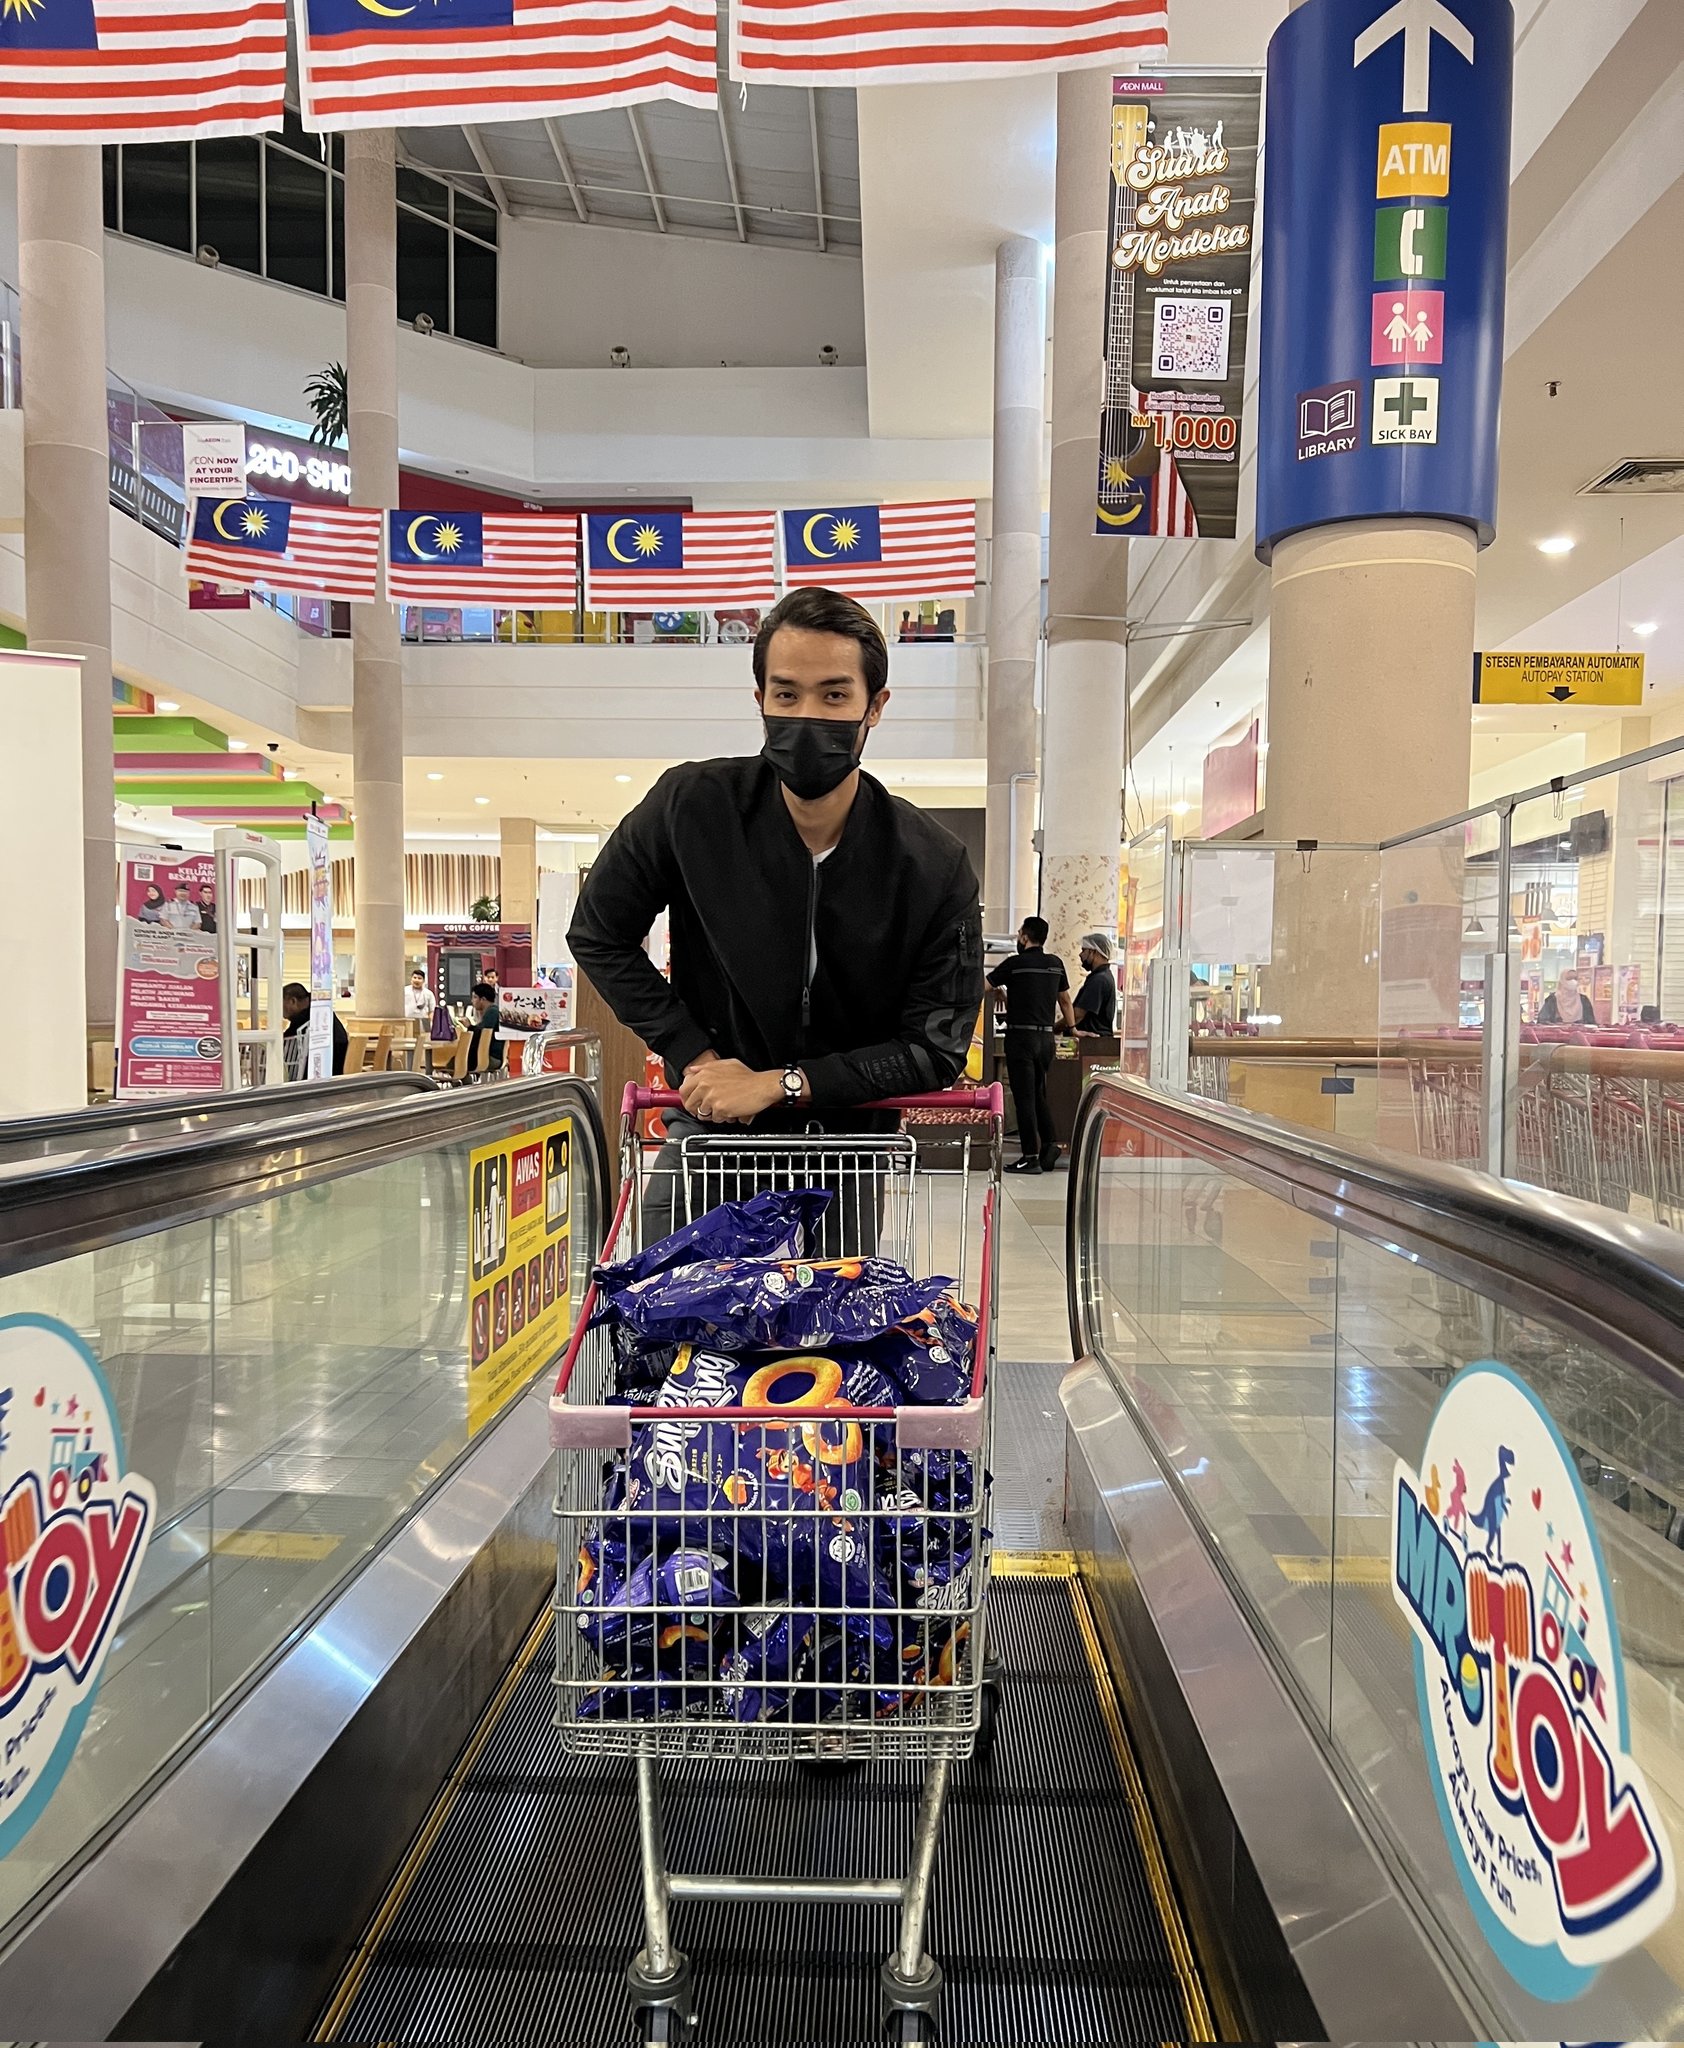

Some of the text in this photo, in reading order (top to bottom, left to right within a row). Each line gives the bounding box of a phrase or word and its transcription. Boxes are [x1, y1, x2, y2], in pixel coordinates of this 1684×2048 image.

[1142, 82, 1164, 91] MALL
[1126, 146, 1229, 190] Suara
[1382, 143, 1447, 177] ATM
[1136, 185, 1230, 232] Anak
[1112, 225, 1250, 277] Merdeka
[1131, 413, 1236, 453] RM 1,000
[1298, 436, 1356, 460] LIBRARY
[1378, 429, 1432, 440] SICK BAY
[1485, 656, 1640, 669] STESEN PEMBAYARAN AUTOMATIK
[1521, 670, 1604, 682] AUTOPAY STATION
[168, 873, 198, 882] BESAR
[443, 924, 500, 932] COSTA COFFEE
[515, 1151, 541, 1187] AWAS
[1441, 1677, 1469, 1792] Always
[1471, 1788, 1494, 1848] Low
[1449, 1772, 1517, 1915] Always Fun.
